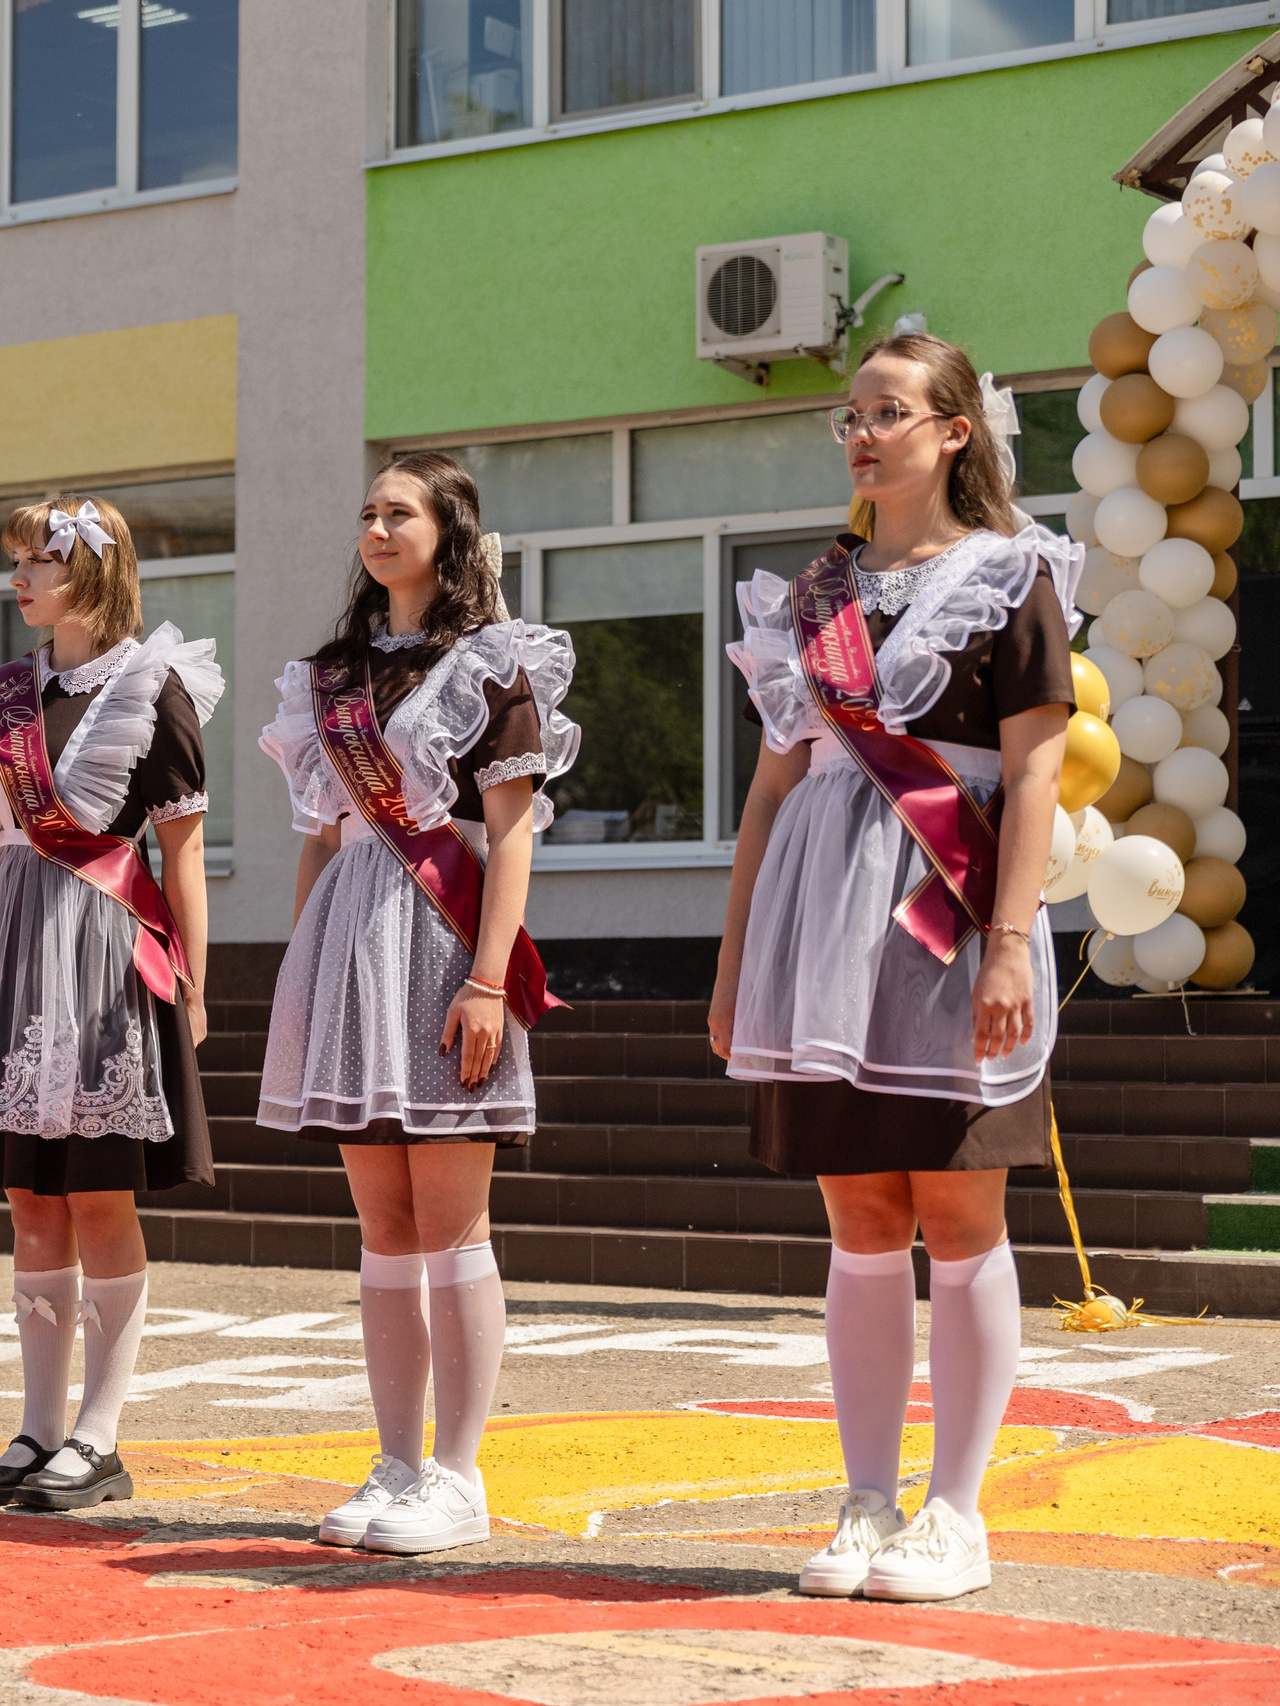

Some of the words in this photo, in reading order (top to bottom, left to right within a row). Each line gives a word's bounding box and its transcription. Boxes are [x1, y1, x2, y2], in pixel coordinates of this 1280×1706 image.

[800, 577, 849, 685] Выпускница
[0, 705, 38, 811] Выпускница
[325, 684, 386, 794] Выпускница
